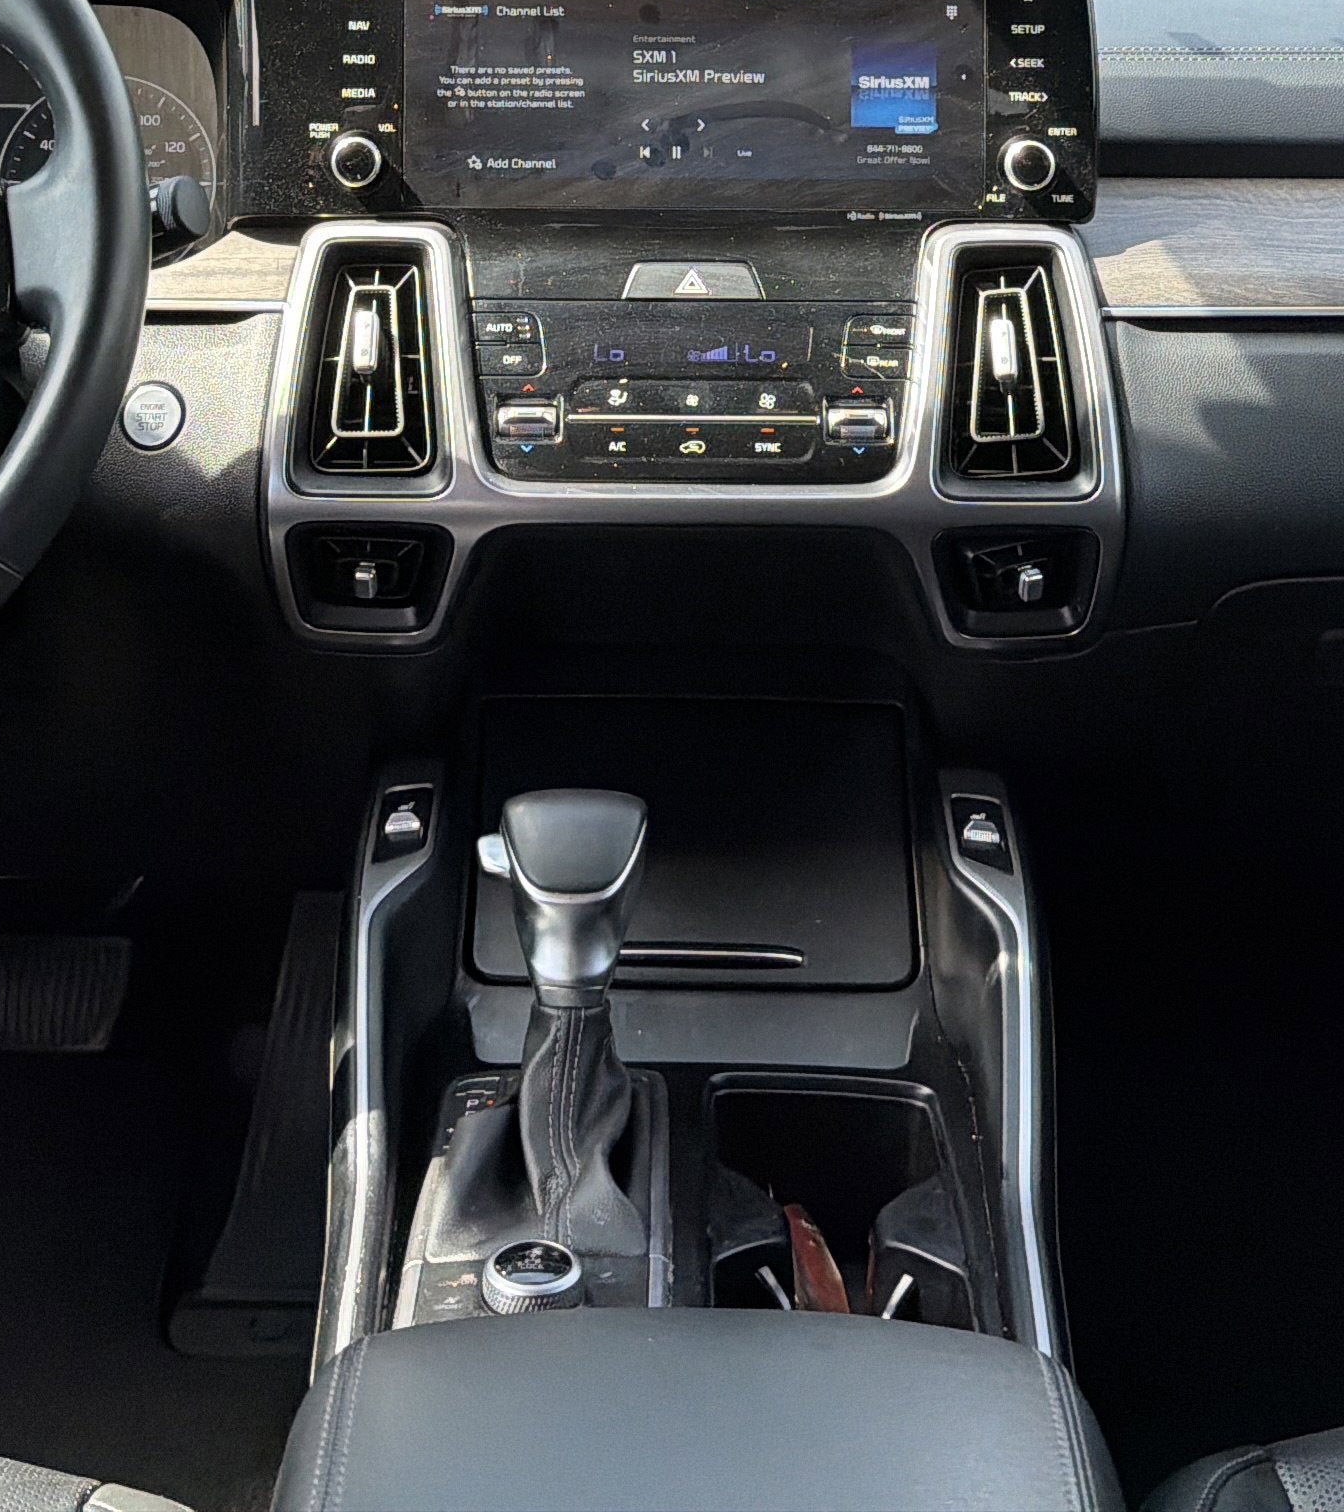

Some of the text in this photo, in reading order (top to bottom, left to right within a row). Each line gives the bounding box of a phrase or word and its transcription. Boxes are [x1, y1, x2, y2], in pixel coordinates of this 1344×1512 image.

[496, 6, 565, 16] Channel List
[348, 20, 370, 30] NAV
[1010, 25, 1045, 34] SETUP
[632, 35, 696, 43] Entertainment
[342, 55, 376, 64] RADIO
[633, 50, 677, 64] SXM 1
[1017, 58, 1045, 68] SEEK
[450, 66, 475, 74] There
[508, 66, 534, 74] saved
[633, 69, 765, 83] SiriusXM Preview
[439, 77, 455, 85] You
[474, 77, 492, 85] add
[500, 77, 531, 86] preset
[532, 77, 544, 86] by
[545, 77, 583, 86] pressing
[858, 75, 930, 89] SiriusXM
[341, 88, 376, 98] MEDIA
[437, 89, 452, 97] the
[468, 89, 498, 97] button
[513, 89, 528, 97] the
[529, 89, 552, 97] radio
[1009, 92, 1042, 102] TRACK
[460, 100, 468, 108] in
[470, 100, 485, 108] the
[487, 100, 555, 108] station/channel
[140, 115, 161, 126] 100
[309, 123, 338, 132] POWER
[378, 123, 397, 132] VOL
[1048, 127, 1077, 137] ENTER
[165, 142, 185, 153] 120
[487, 158, 556, 169] Add Channel
[884, 156, 907, 164] Offer
[986, 193, 1006, 203] FILE
[1052, 194, 1074, 203] TUNE
[486, 323, 513, 332] AUTO
[503, 355, 523, 364] OFF
[136, 413, 168, 422] START
[137, 422, 164, 431] STOP
[608, 441, 627, 452] A/C
[754, 443, 782, 452] SYNC
